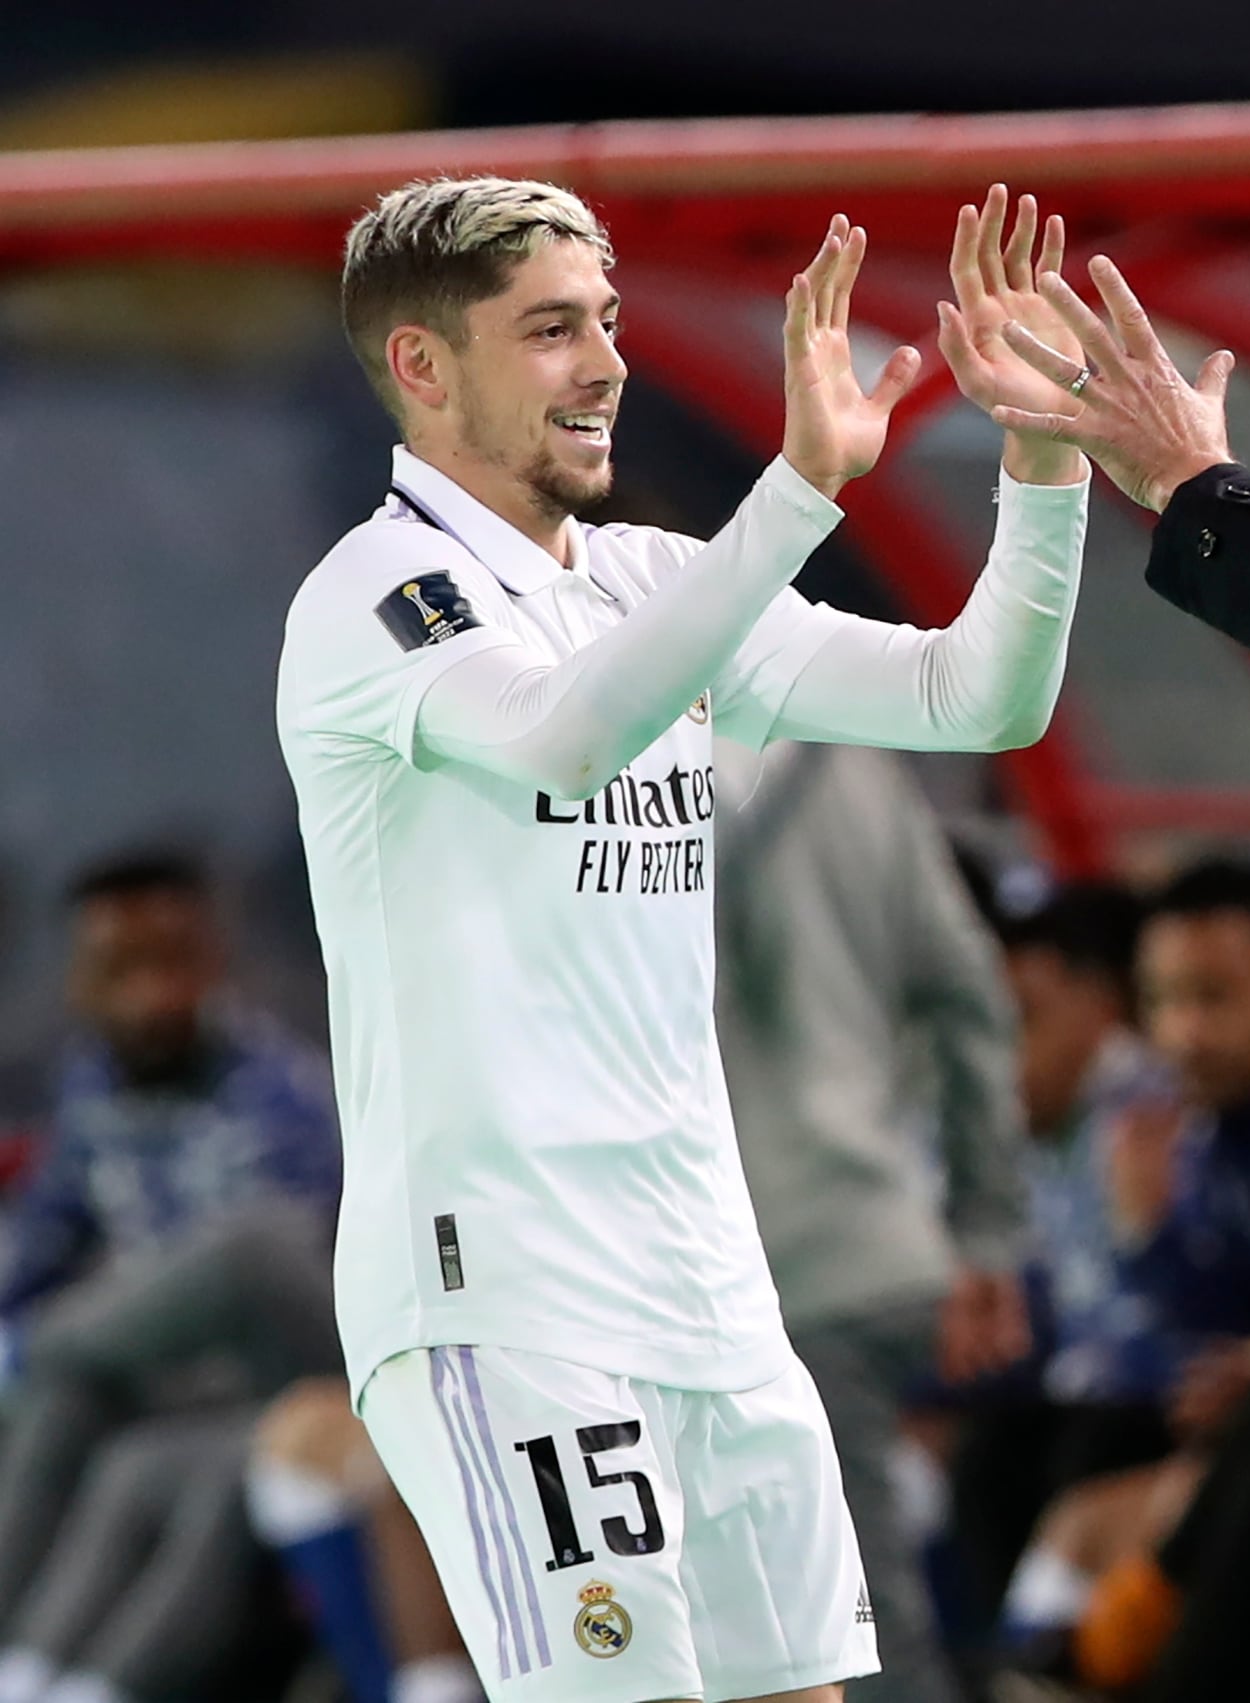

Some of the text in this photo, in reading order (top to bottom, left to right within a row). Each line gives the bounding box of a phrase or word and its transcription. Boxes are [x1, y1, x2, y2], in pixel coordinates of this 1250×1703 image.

[576, 837, 704, 894] FLY BETTER
[513, 1419, 665, 1573] 15
